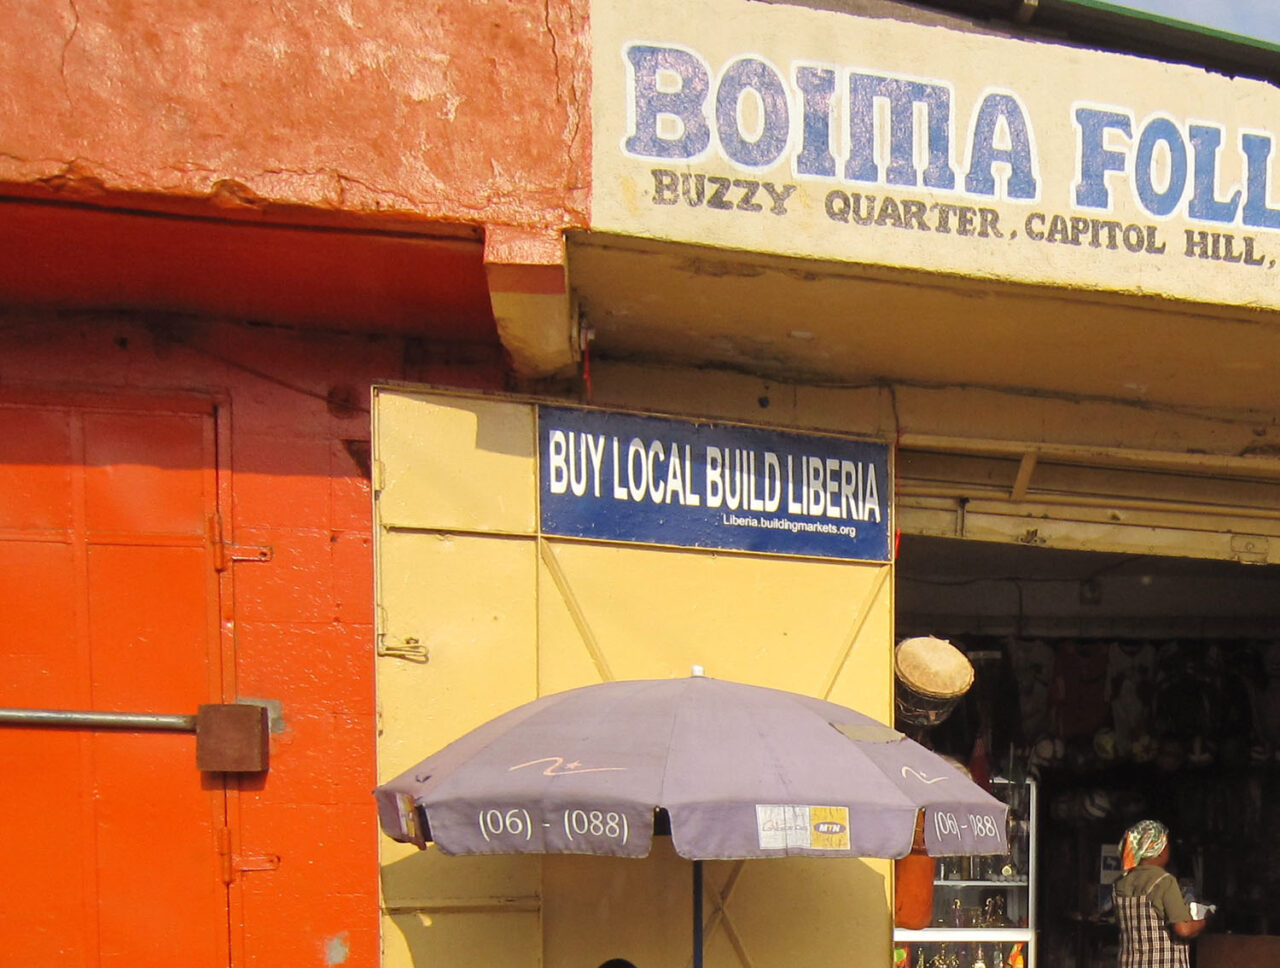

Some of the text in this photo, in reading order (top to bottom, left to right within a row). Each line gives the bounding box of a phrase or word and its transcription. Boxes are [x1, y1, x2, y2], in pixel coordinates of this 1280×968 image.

[624, 44, 1039, 200] BOIMA
[651, 168, 797, 216] BUZZY
[824, 189, 1017, 241] QUARTER,
[1024, 211, 1167, 255] CAPITOL
[1184, 229, 1275, 269] HILL,
[550, 430, 880, 523] BUY LOCAL BUILD LIBERIA
[723, 513, 857, 538] Liberia.buildingmarkets.org
[479, 809, 532, 842] (06)
[564, 808, 629, 845] (088)
[818, 823, 841, 833] MTN
